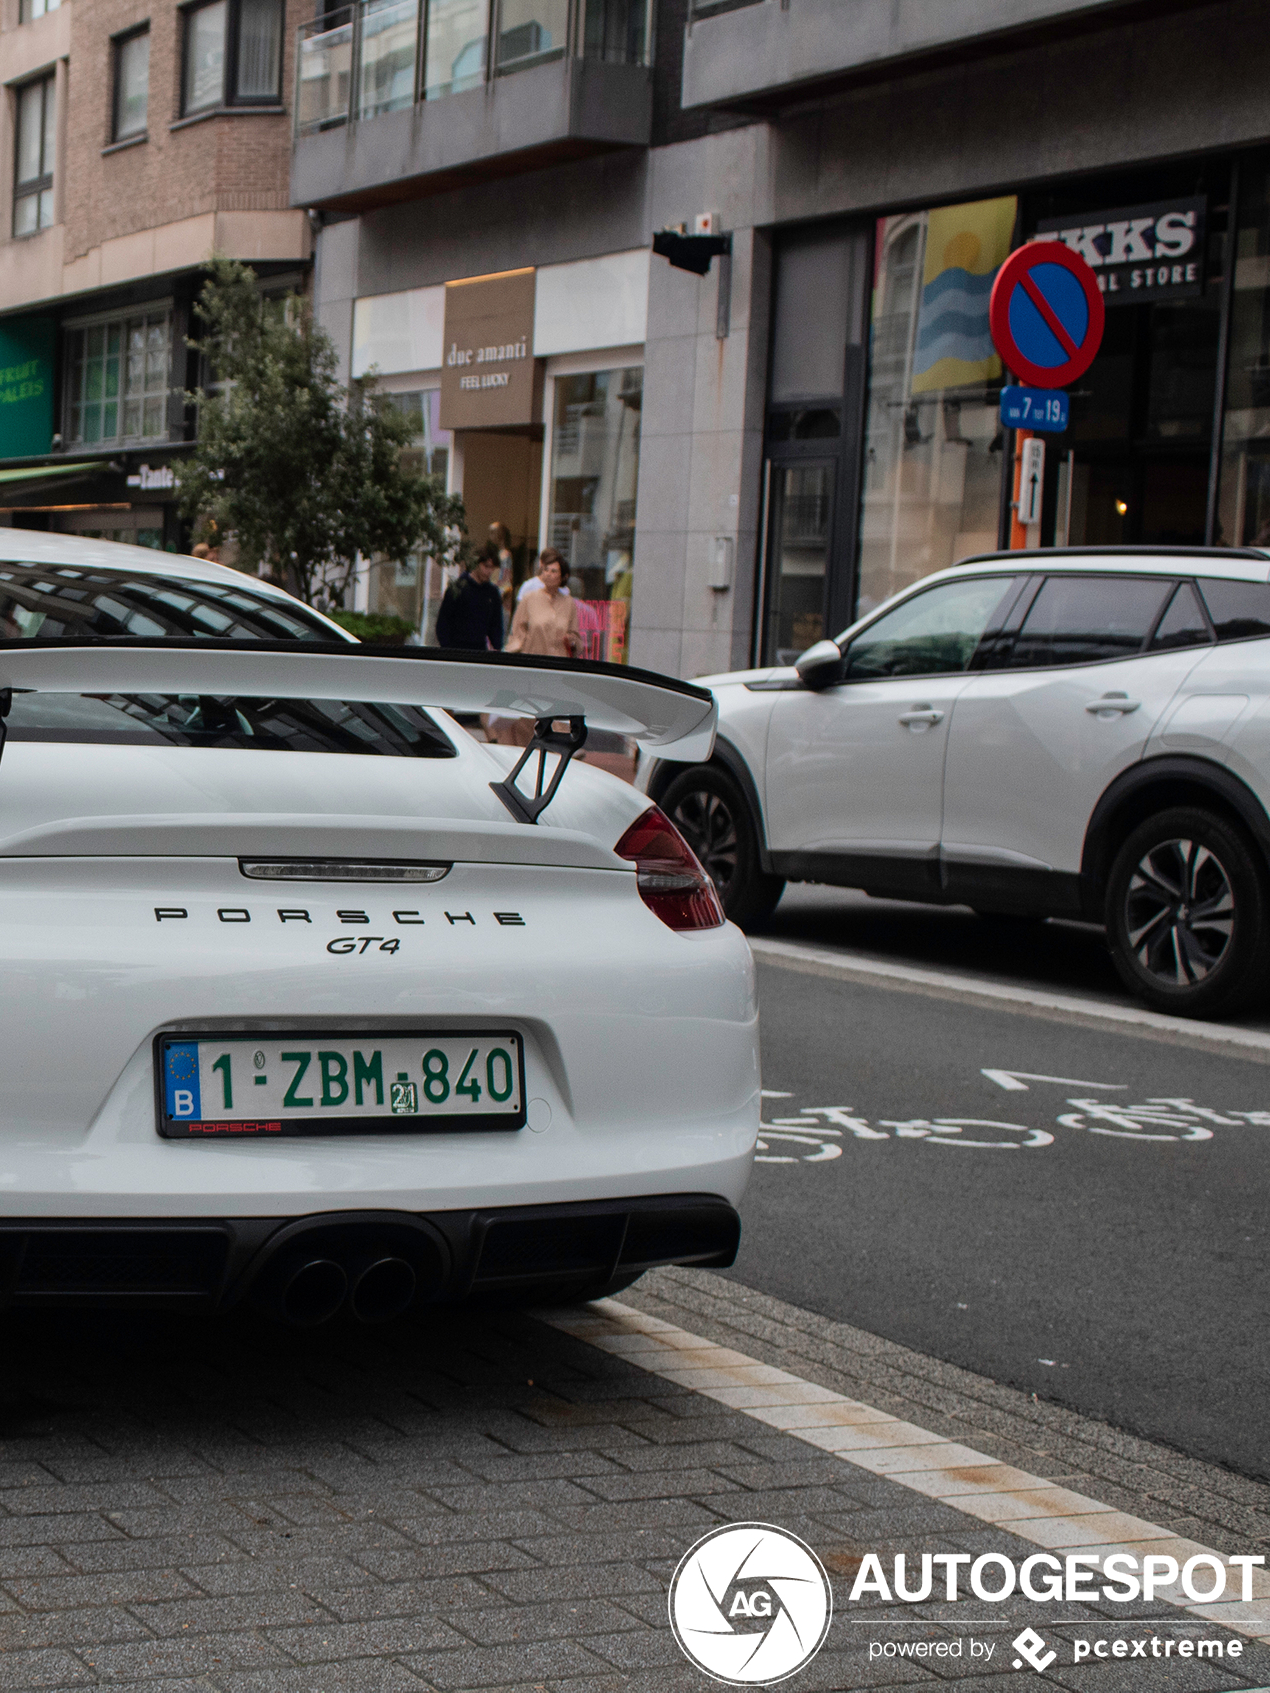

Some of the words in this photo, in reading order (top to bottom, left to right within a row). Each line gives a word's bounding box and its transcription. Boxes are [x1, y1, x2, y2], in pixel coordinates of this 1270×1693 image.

[1033, 211, 1197, 267] KKS
[1130, 263, 1197, 289] STORE
[447, 342, 473, 366] due
[477, 335, 526, 362] amanti
[459, 375, 480, 390] FEEL
[481, 372, 509, 388] LUCKY
[1023, 396, 1032, 419] 7
[1046, 399, 1060, 422] 19
[154, 907, 526, 926] PORSCHE
[326, 937, 401, 955] GT4
[174, 1089, 195, 1117] B
[188, 1122, 282, 1133] PORSCHE
